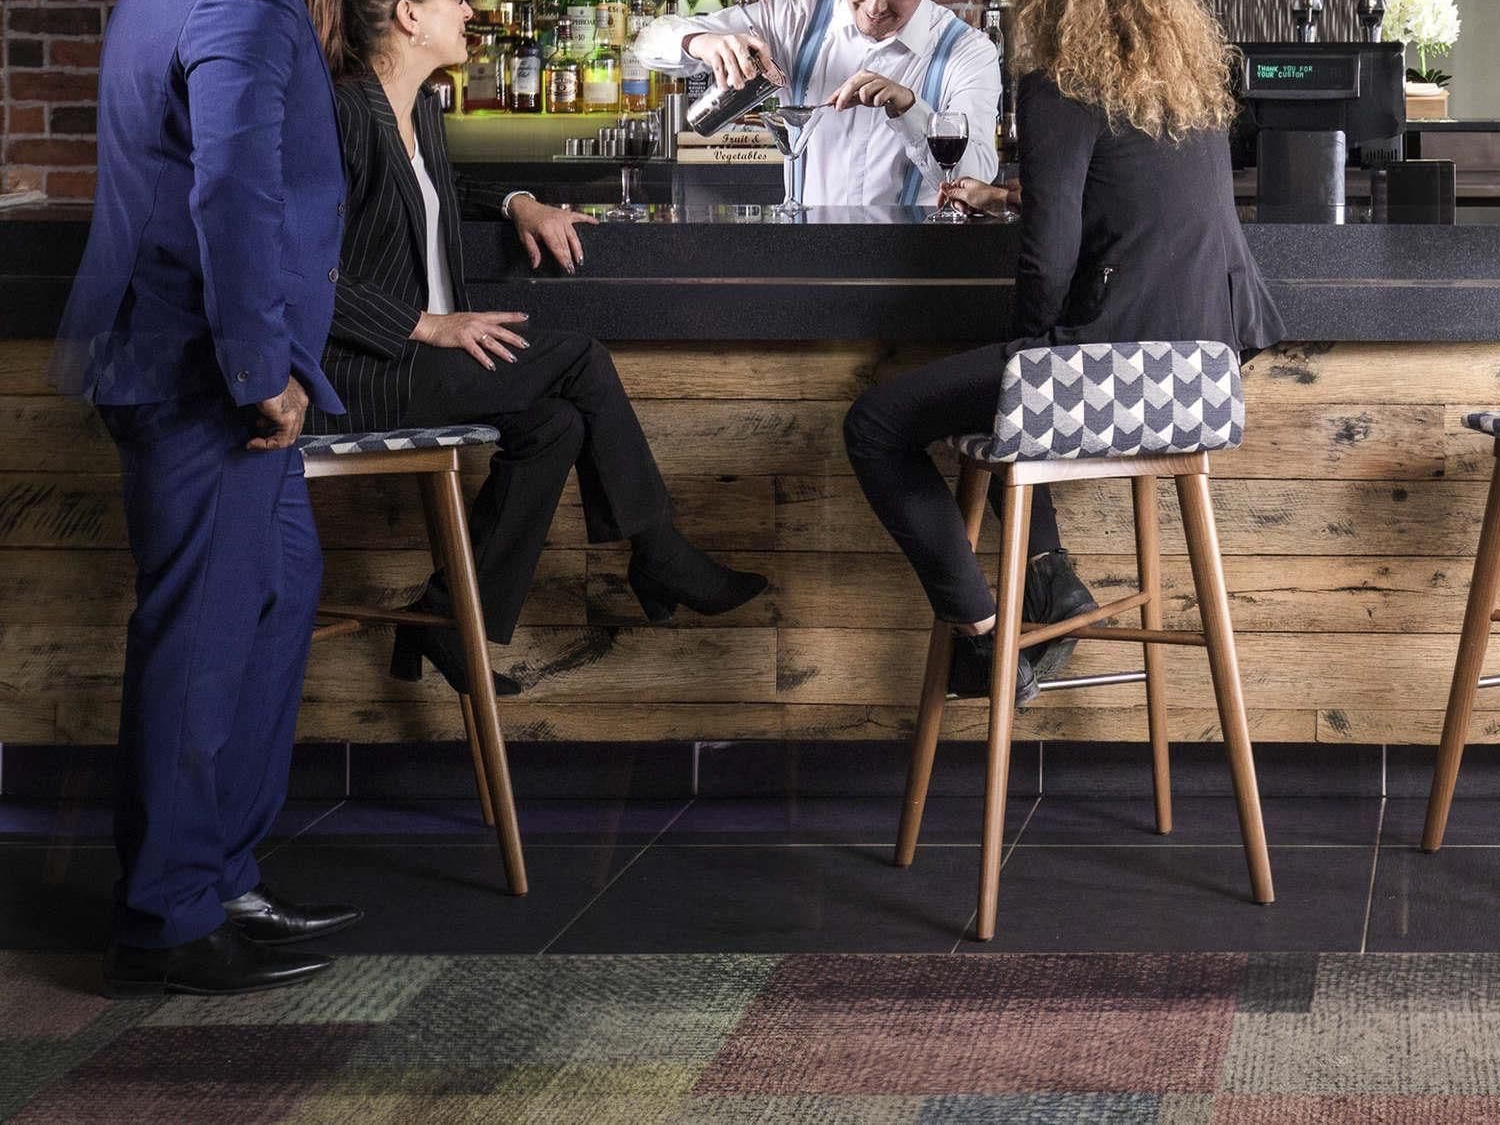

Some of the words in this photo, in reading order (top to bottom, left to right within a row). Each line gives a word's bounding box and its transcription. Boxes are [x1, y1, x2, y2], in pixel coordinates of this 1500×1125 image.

[1299, 65, 1313, 73] FOR
[1278, 71, 1305, 79] CUSTOM
[722, 134, 748, 144] Fruit
[751, 134, 760, 144] &
[713, 150, 767, 165] Vegetables
